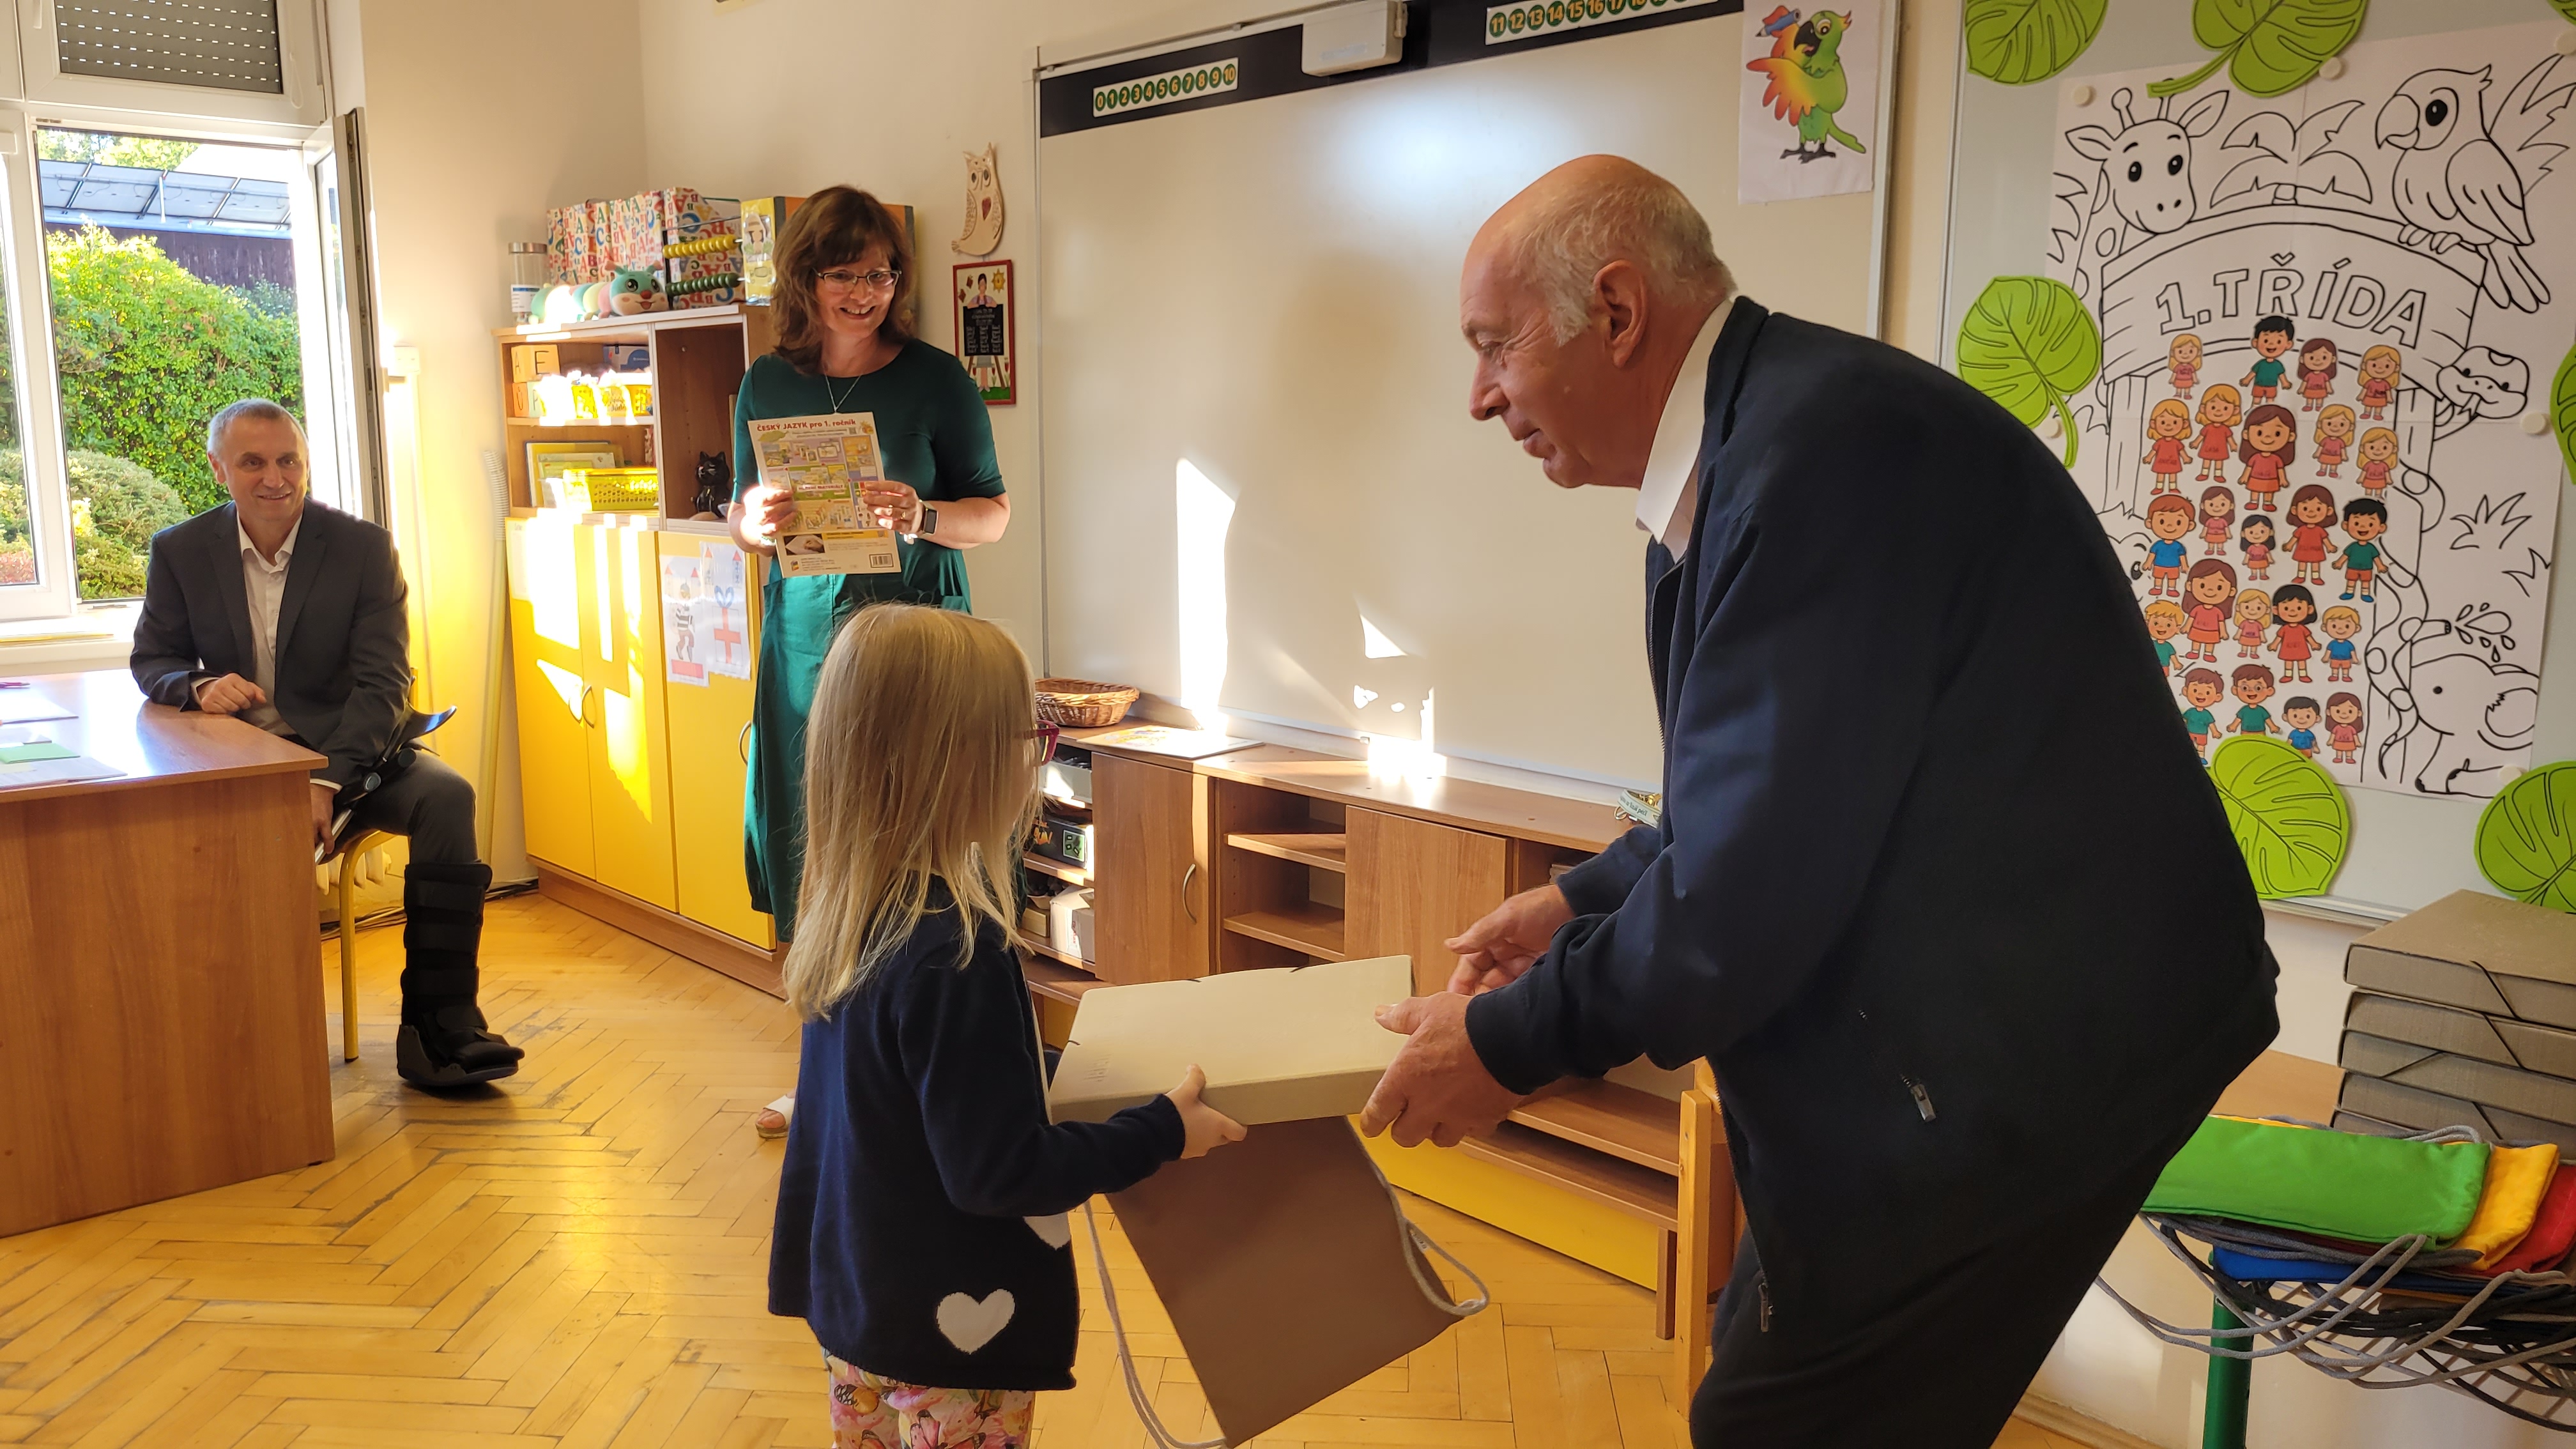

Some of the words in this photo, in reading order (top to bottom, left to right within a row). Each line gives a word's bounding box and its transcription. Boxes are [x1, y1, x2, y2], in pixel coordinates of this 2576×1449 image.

[1491, 16, 1505, 32] 11
[1508, 13, 1524, 29] 12
[1528, 10, 1543, 25] 13
[1547, 5, 1563, 21] 14
[1568, 1, 1584, 19] 15
[1098, 96, 1103, 107] 0
[1110, 93, 1115, 105] 1
[1122, 90, 1128, 102] 2
[1135, 88, 1140, 100] 3
[1146, 85, 1152, 97] 4
[1158, 82, 1165, 95] 5
[1172, 79, 1178, 92] 6
[1186, 77, 1192, 89] 7
[1199, 74, 1205, 87] 8
[1213, 70, 1219, 84] 9
[1223, 68, 1235, 81] 10
[515, 351, 521, 376] A
[535, 350, 549, 376] E
[756, 424, 781, 432] ČESKÝ
[783, 422, 808, 430] JAZYK
